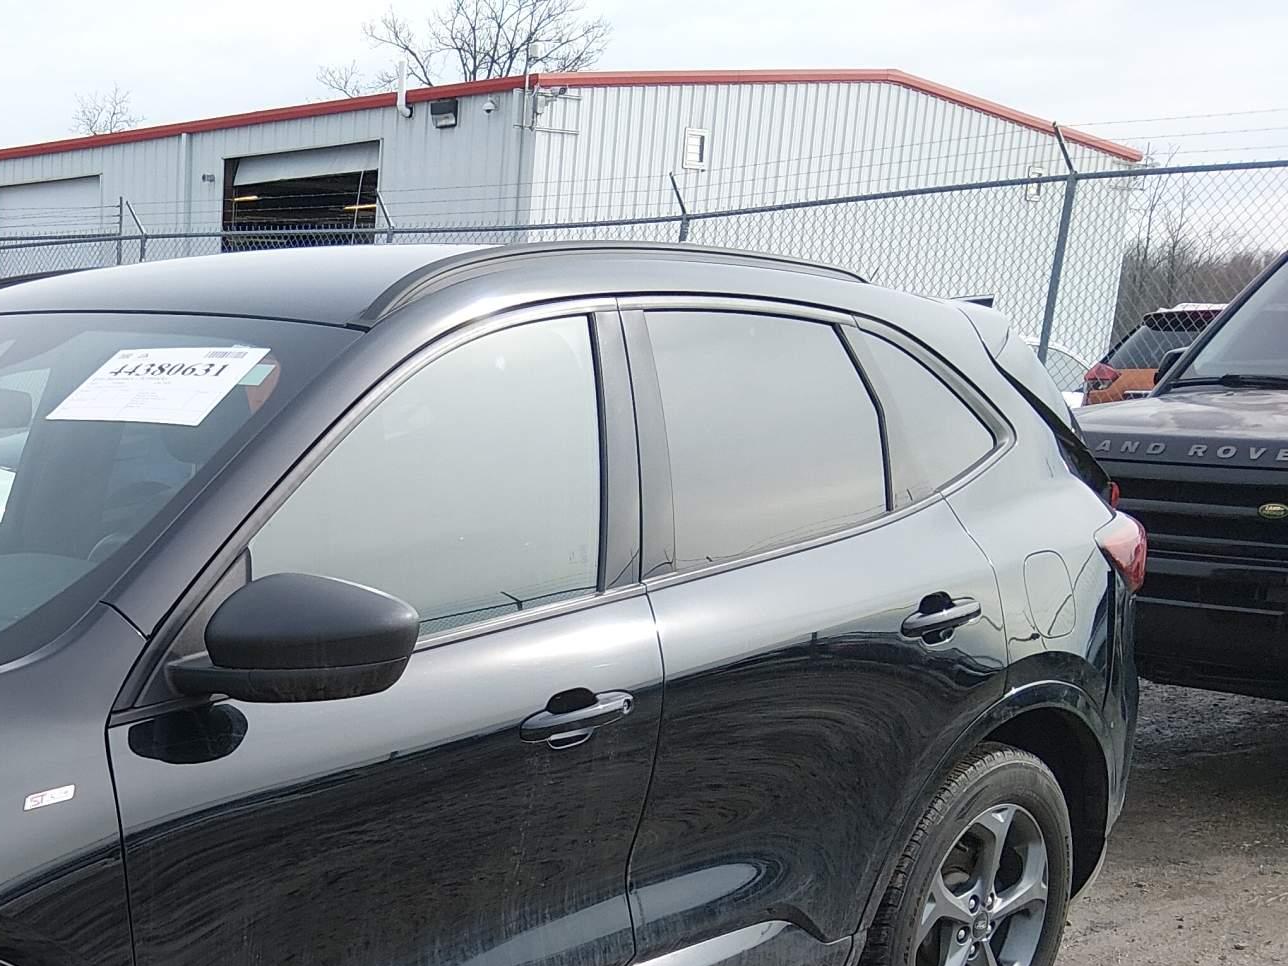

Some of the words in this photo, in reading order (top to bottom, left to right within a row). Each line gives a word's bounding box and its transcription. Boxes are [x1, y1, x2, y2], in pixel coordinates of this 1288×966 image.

[109, 362, 229, 377] 44380631
[1095, 439, 1166, 455] AND
[1188, 444, 1288, 462] ROVE
